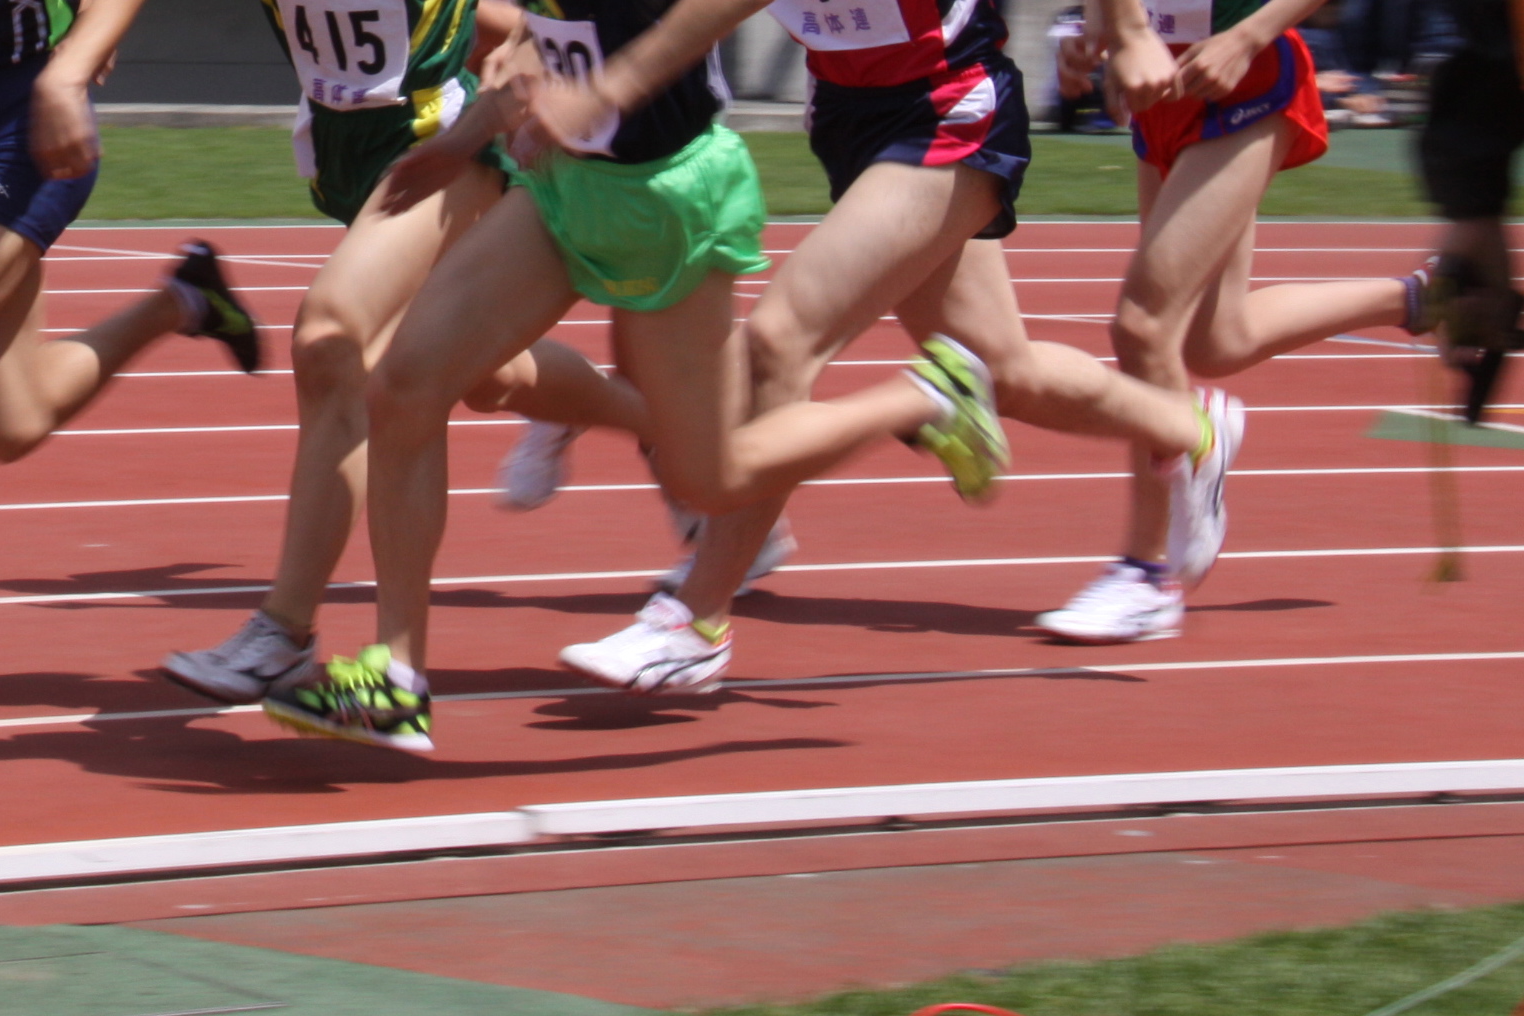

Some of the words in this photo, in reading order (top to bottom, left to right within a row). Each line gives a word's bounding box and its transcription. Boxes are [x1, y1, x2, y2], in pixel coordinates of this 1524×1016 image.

[294, 5, 385, 75] 415
[802, 7, 871, 35] 高体連
